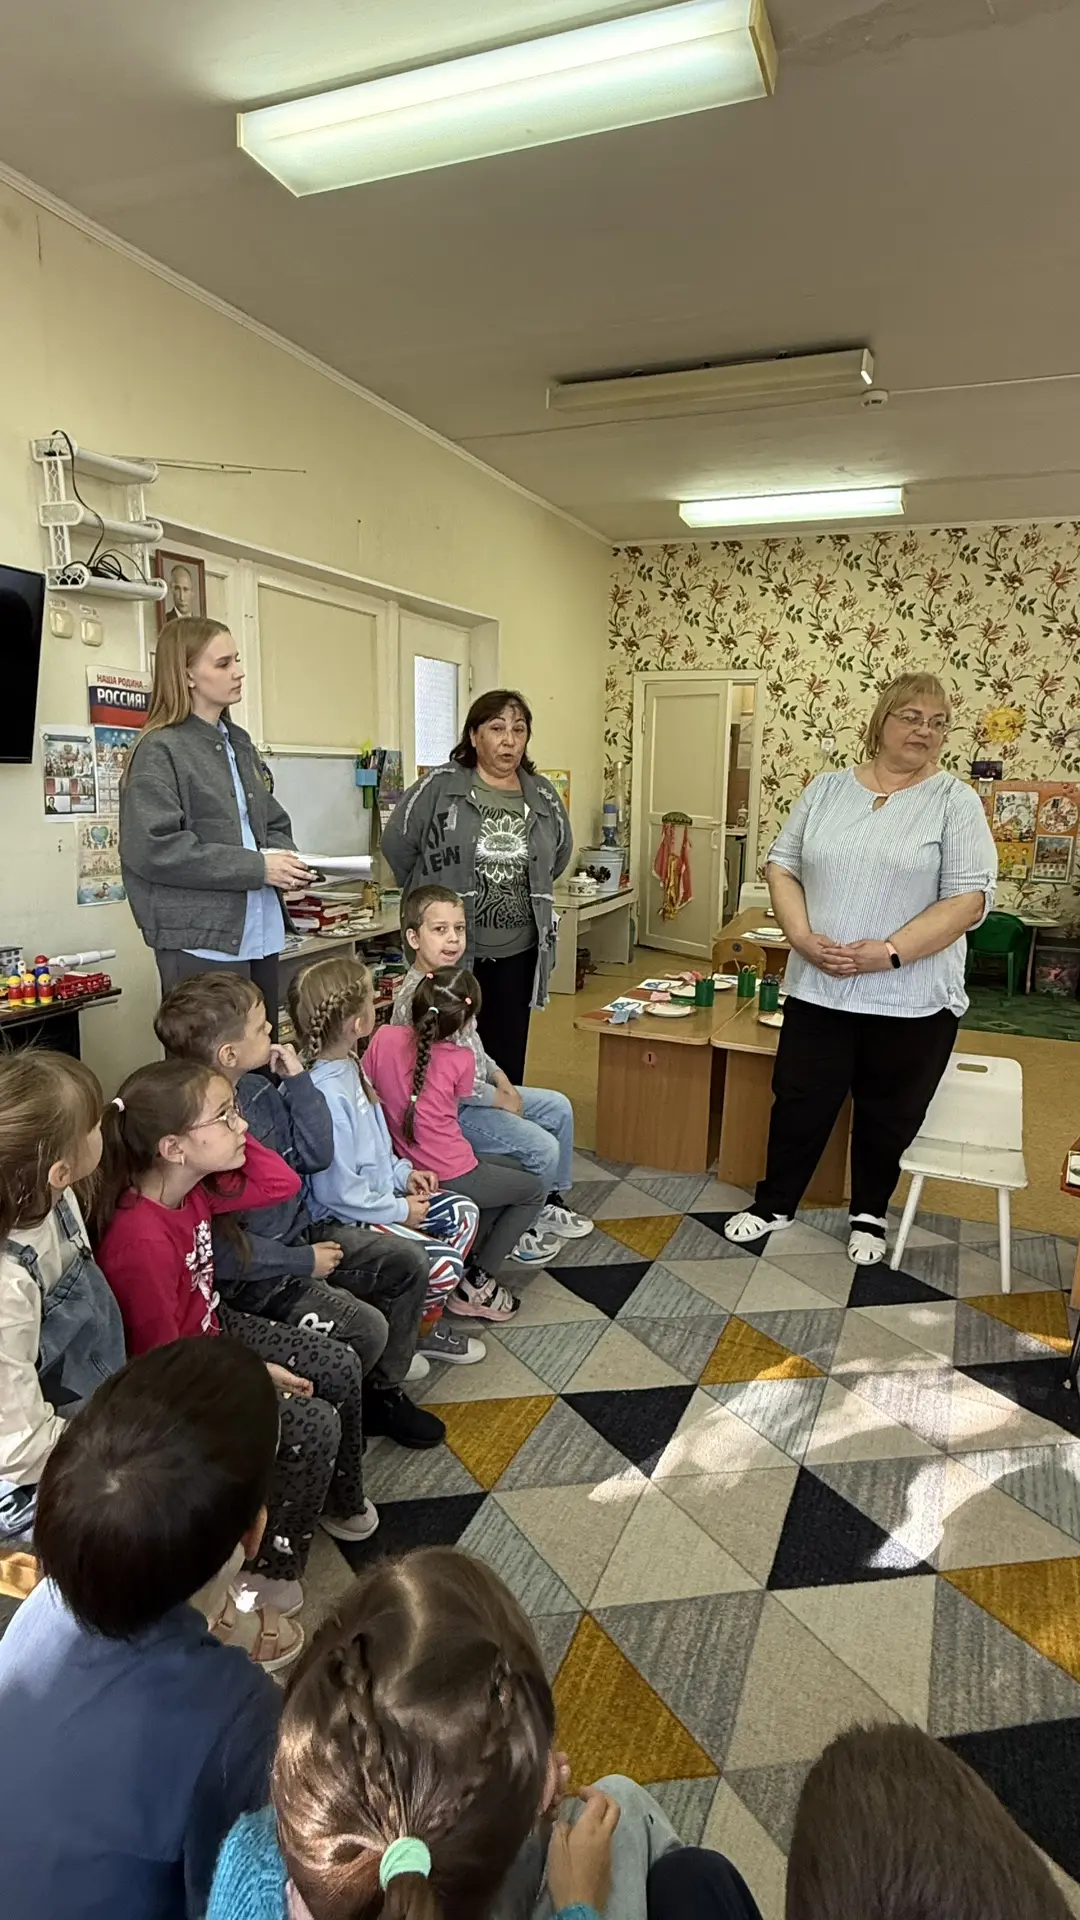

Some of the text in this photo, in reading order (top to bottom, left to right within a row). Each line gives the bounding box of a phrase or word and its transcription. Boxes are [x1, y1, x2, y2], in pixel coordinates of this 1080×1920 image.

[97, 674, 117, 685] НАША
[118, 677, 143, 688] РОДИНА
[96, 688, 146, 708] РОССИЯ!
